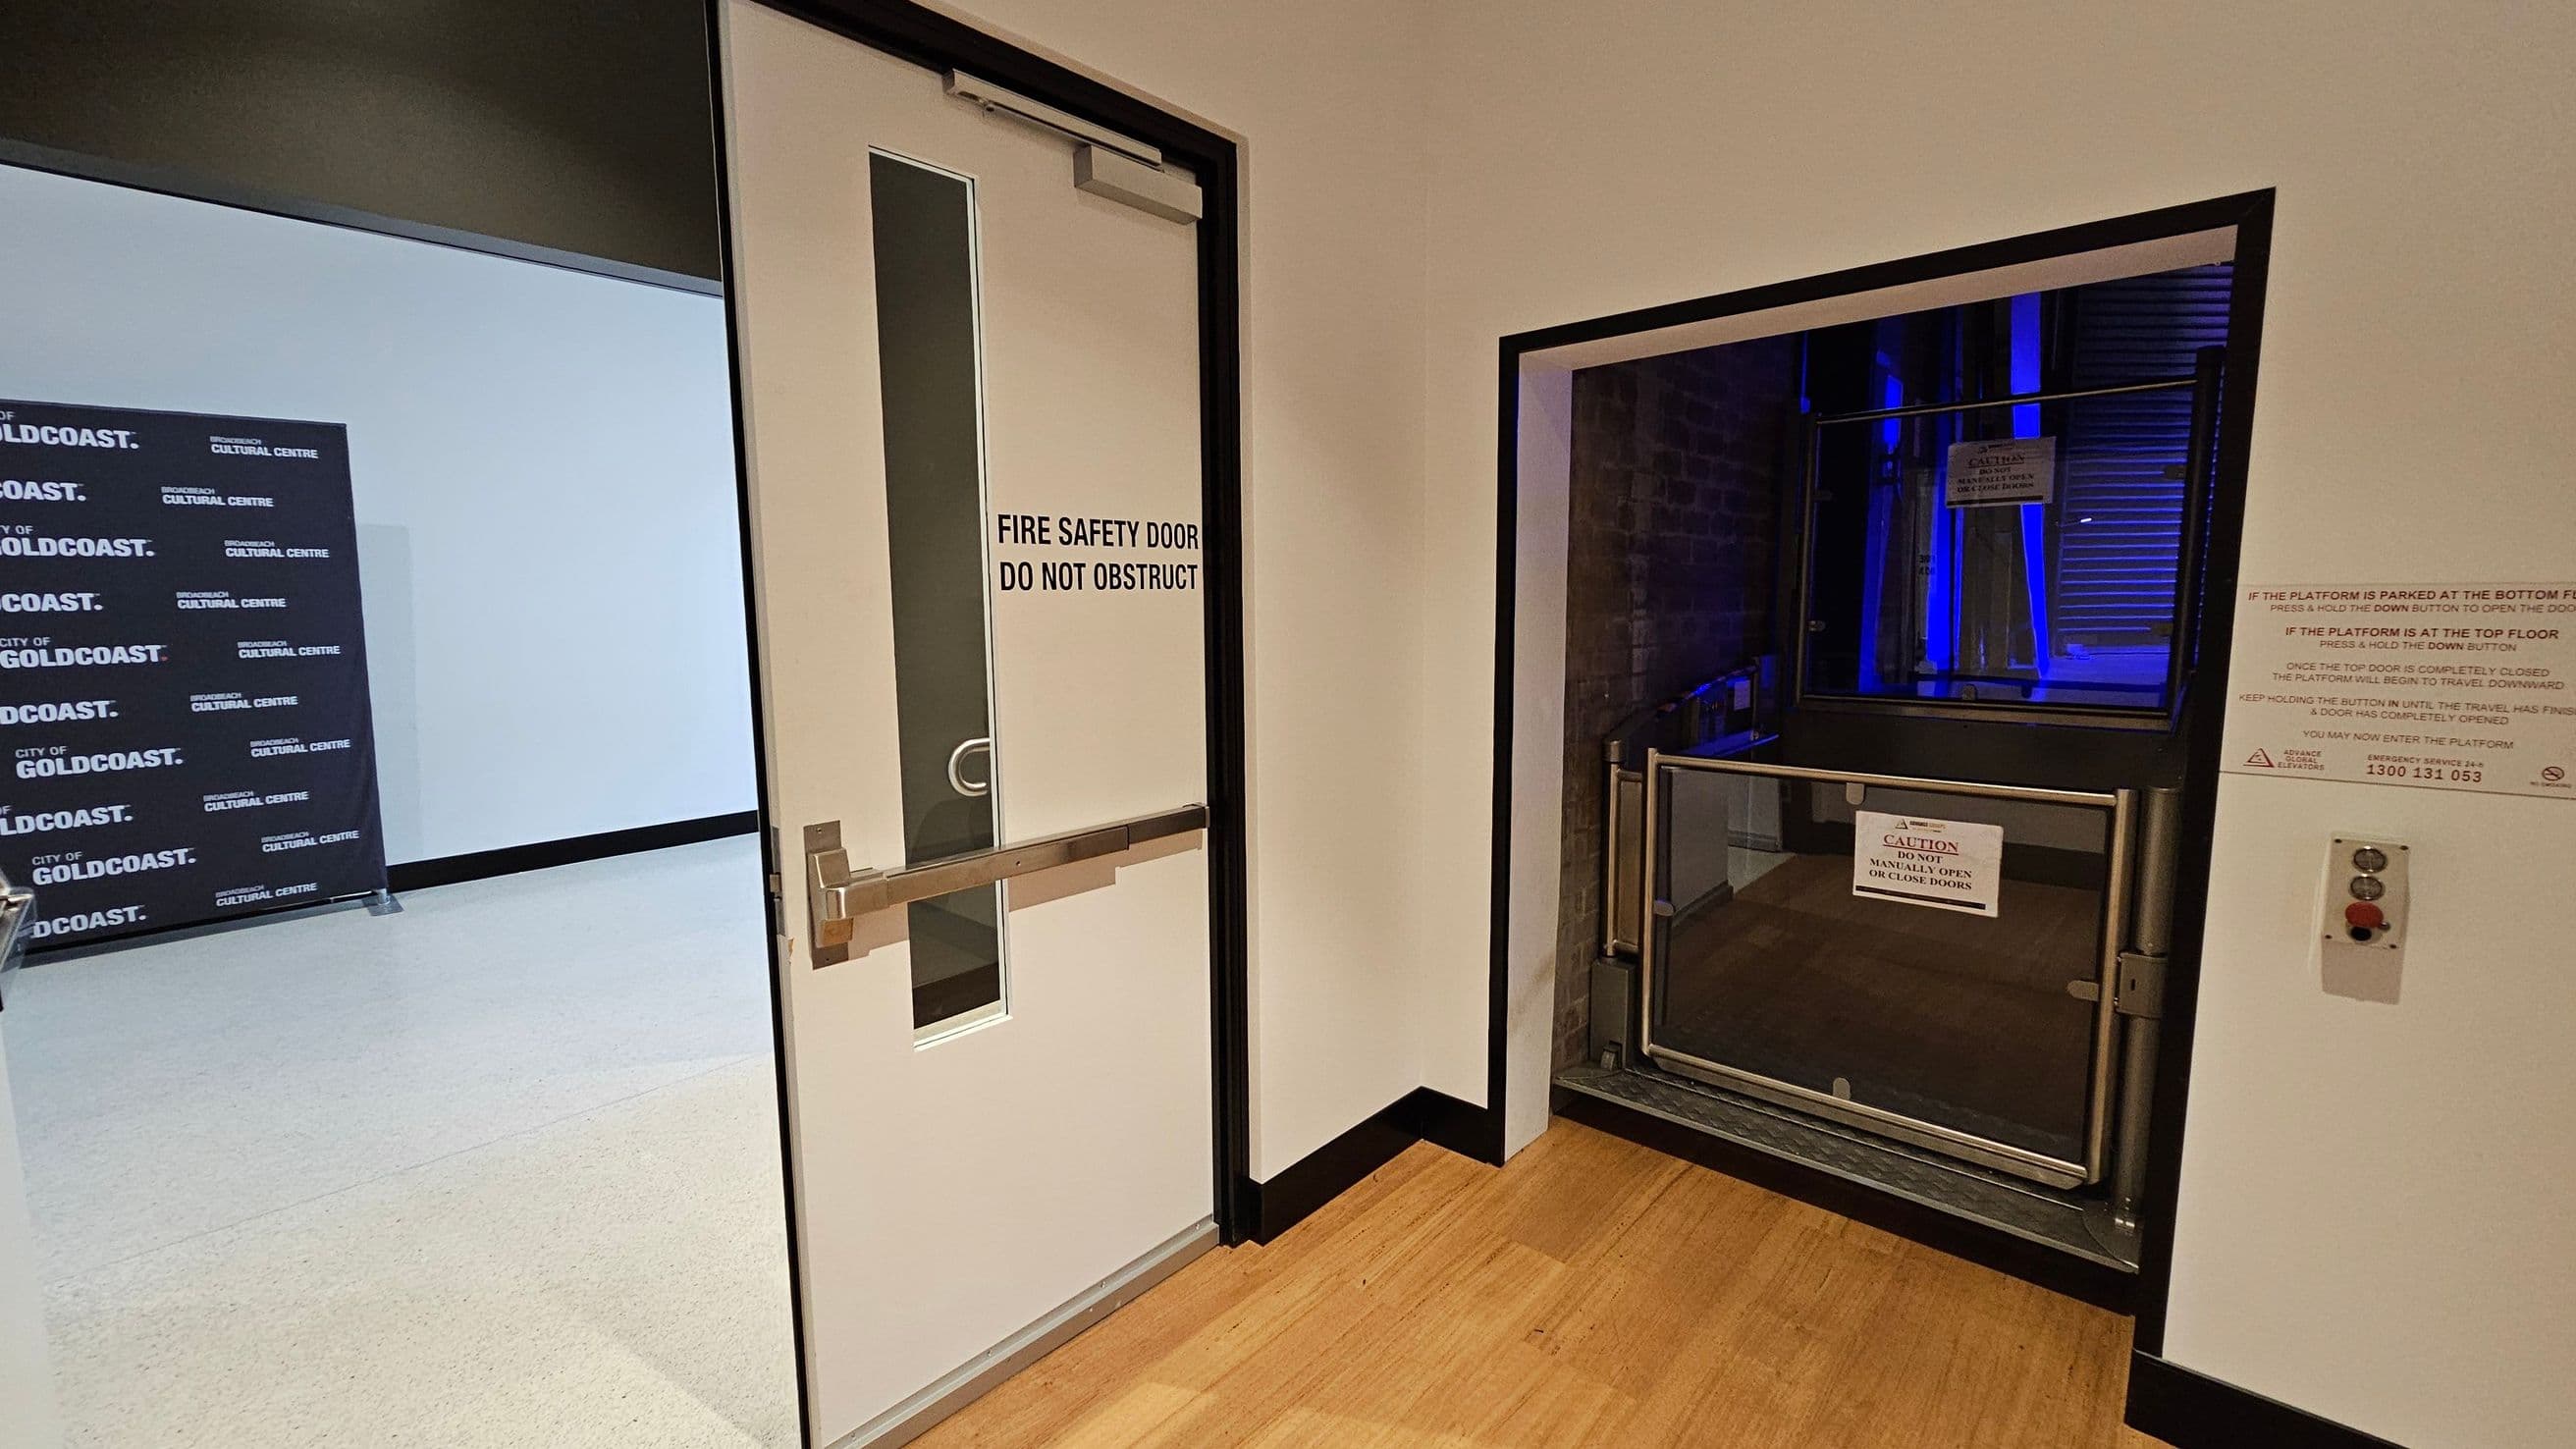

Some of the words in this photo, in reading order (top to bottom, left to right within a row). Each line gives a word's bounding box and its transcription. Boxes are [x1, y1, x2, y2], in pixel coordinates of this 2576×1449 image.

[211, 444, 271, 456] CULTURAL
[274, 447, 319, 459] CENTRE
[162, 494, 226, 506] CULTURAL
[228, 496, 274, 507] CENTRE
[15, 525, 34, 535] OF
[998, 514, 1051, 544] FIRE
[1059, 517, 1139, 547] SAFETY
[1147, 521, 1198, 549] DOOR
[225, 548, 285, 558] CULTURAL
[287, 549, 330, 558] CENTRE
[999, 561, 1033, 590] DO
[1042, 562, 1086, 590] NOT
[1094, 563, 1198, 590] OBSTRUCT
[2249, 591, 2258, 601] IF
[2263, 591, 2286, 601] THE
[2290, 591, 2360, 600] PLATFORM
[2363, 591, 2376, 600] IS
[2380, 590, 2436, 600] PARKED
[2440, 590, 2459, 599] AT
[2463, 590, 2490, 599] THE
[2495, 590, 2558, 599] BOTTOM
[177, 598, 240, 609] CULTURAL
[241, 598, 287, 608] CENTRE
[2374, 604, 2409, 613] DOWN
[2412, 604, 2460, 613] BUTTON
[2463, 604, 2479, 613] TO
[2482, 604, 2516, 613] OPEN
[2520, 604, 2544, 613] THE
[2285, 627, 2297, 636] IF
[2301, 627, 2325, 636] THE
[2328, 627, 2400, 637] PLATFORM
[2404, 628, 2416, 637] IS
[2420, 628, 2439, 638] AT
[2442, 628, 2470, 638] THE
[2475, 629, 2503, 638] TOP
[2507, 630, 2559, 639] FLOOR
[0, 638, 28, 647] CITY
[33, 637, 51, 646] OF
[2369, 641, 2399, 649] HOLD
[2403, 642, 2424, 650] THE
[2428, 642, 2464, 650] DOWN
[2467, 643, 2517, 651] BUTTON
[239, 648, 297, 658] CULTURAL
[298, 645, 341, 656] CENTRE
[2287, 662, 2316, 671] ONCE
[2344, 664, 2365, 672] TOP
[2368, 664, 2401, 672] DOOR
[2418, 666, 2496, 675] COMPLETELY
[2500, 668, 2550, 677] CLOSED
[2273, 673, 2292, 681] THE
[2295, 674, 2352, 683] PLATFORM
[2355, 675, 2379, 684] WILL
[2384, 676, 2418, 685] BEGIN
[2422, 677, 2437, 686] TO
[2441, 678, 2483, 687] TRAVEL
[2489, 679, 2565, 690] DOWNWARD
[191, 700, 252, 712] CULTURAL
[253, 696, 298, 707] CENTRE
[2239, 693, 2265, 701] KEEP
[2268, 695, 2313, 705] HOLDING
[2318, 697, 2339, 705] THE
[2341, 698, 2386, 707] BUTTON
[2388, 699, 2399, 708] IN
[2402, 700, 2434, 709] UNTIL
[2438, 701, 2461, 710] THE
[2465, 703, 2509, 713] TRAVEL
[2513, 705, 2538, 714] HAS
[2320, 708, 2353, 717] DOOR
[2356, 710, 2377, 719] HAS
[2381, 711, 2455, 723] COMPLETELY
[2459, 715, 2509, 725] OPENED
[2303, 730, 2325, 739] YOU
[2328, 731, 2350, 740] MAY
[2353, 733, 2379, 742] NOW
[2383, 734, 2420, 744] ENTER
[2424, 736, 2446, 746] THE
[2449, 738, 2514, 749] PLATFORM
[16, 747, 44, 758] CITY
[50, 746, 68, 755] OF
[251, 745, 308, 757] CULTURAL
[310, 739, 351, 751] CENTRE
[16, 748, 184, 779] GOLDCOAST.
[2278, 762, 2325, 770] ELEVATORS
[2367, 754, 2420, 763] EMERGENCY
[2424, 758, 2461, 766] SERVICE
[2366, 764, 2406, 777] 1300
[2414, 767, 2443, 780] 131
[2451, 770, 2482, 783] 053
[204, 797, 264, 811] CULTURAL
[266, 791, 309, 804] CENTRE
[262, 837, 318, 853] CULTURAL
[320, 830, 360, 844] CENTRE
[1884, 834, 1958, 853] CAUTION
[32, 855, 60, 865] CITY
[66, 851, 83, 861] OF
[1898, 851, 1914, 860] DO
[1917, 853, 1943, 863] NOT
[33, 848, 196, 886] GOLDCOAST.
[1870, 858, 1935, 874] MANUALLY
[1939, 867, 1972, 878] OPEN
[1869, 869, 1885, 879] OR
[1888, 872, 1926, 884] CLOSE
[1930, 878, 1972, 890] DOORS
[216, 891, 273, 907] CULTURAL
[275, 883, 318, 897] CENTRE
